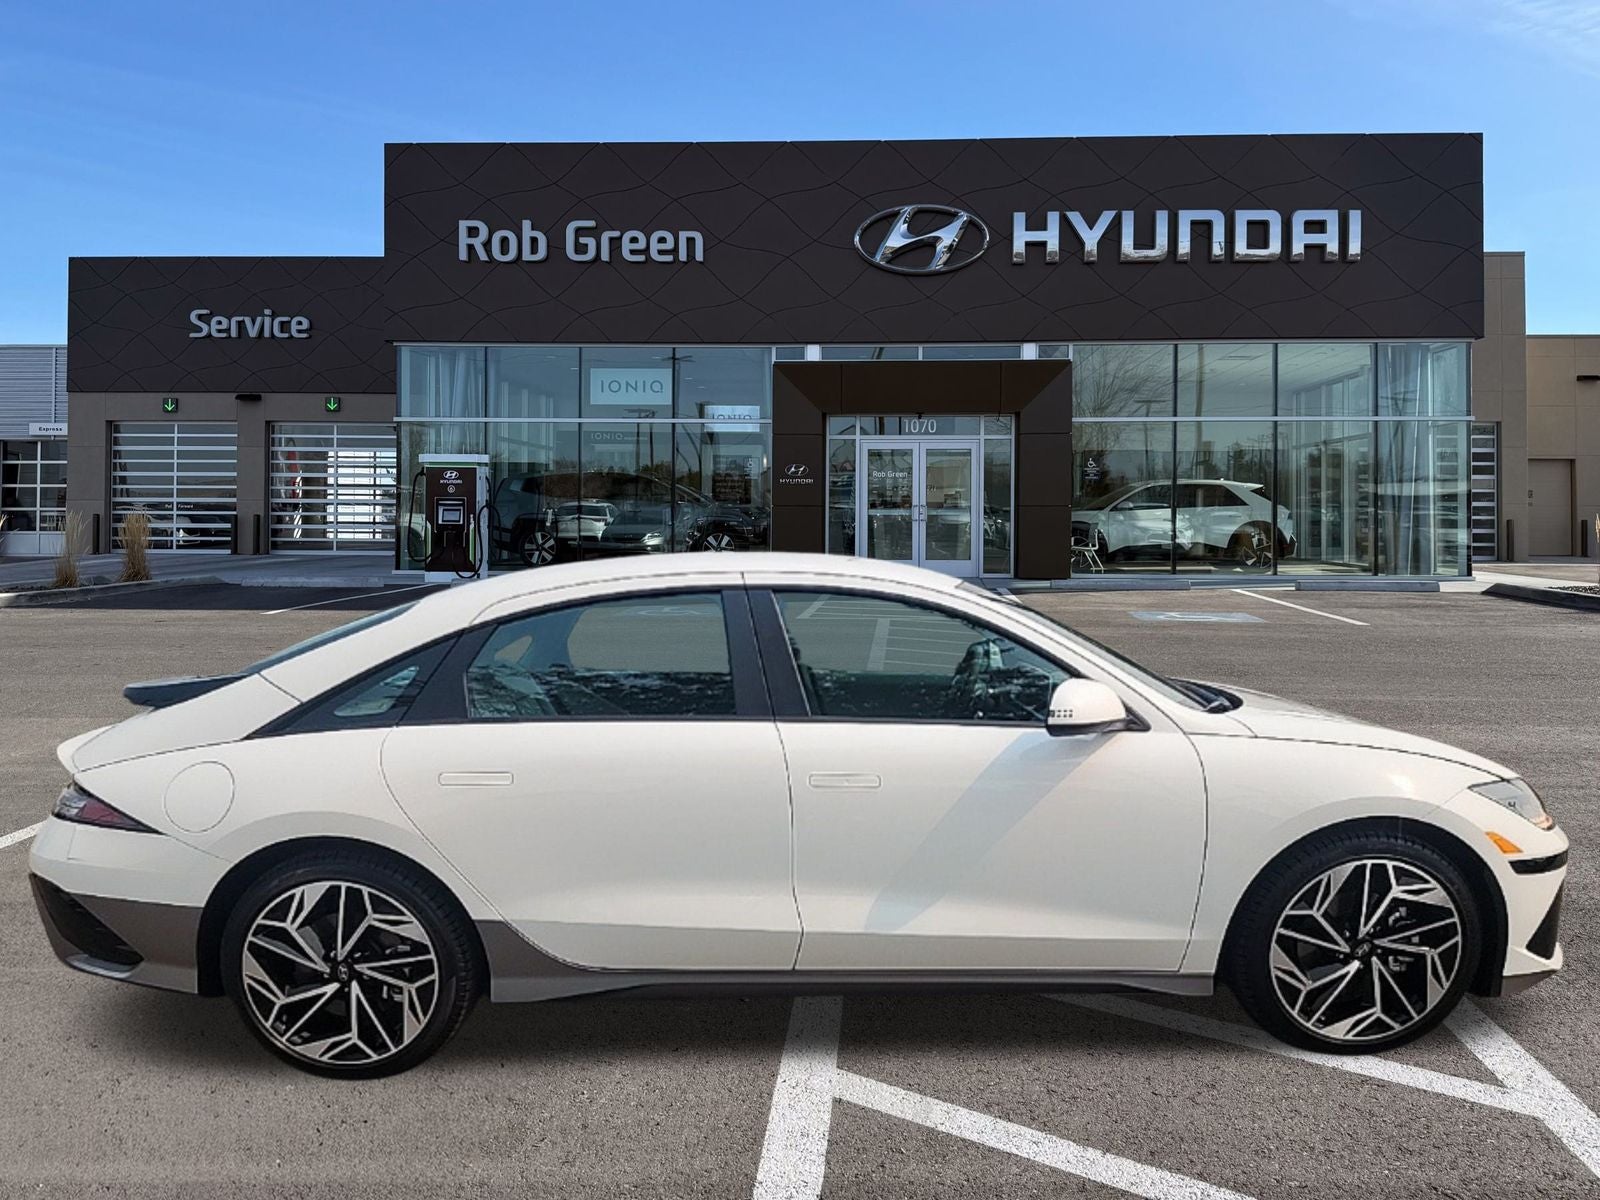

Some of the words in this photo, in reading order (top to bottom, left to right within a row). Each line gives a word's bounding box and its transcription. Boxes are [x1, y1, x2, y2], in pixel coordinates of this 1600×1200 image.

[458, 219, 548, 262] Rob
[565, 219, 704, 262] Green
[1011, 209, 1362, 264] HYUNDAI
[188, 308, 311, 338] Service
[600, 379, 664, 393] IONIQ
[903, 419, 937, 433] 1070
[591, 432, 624, 441] IONIQ
[872, 470, 886, 478] Rob
[887, 470, 908, 478] Green
